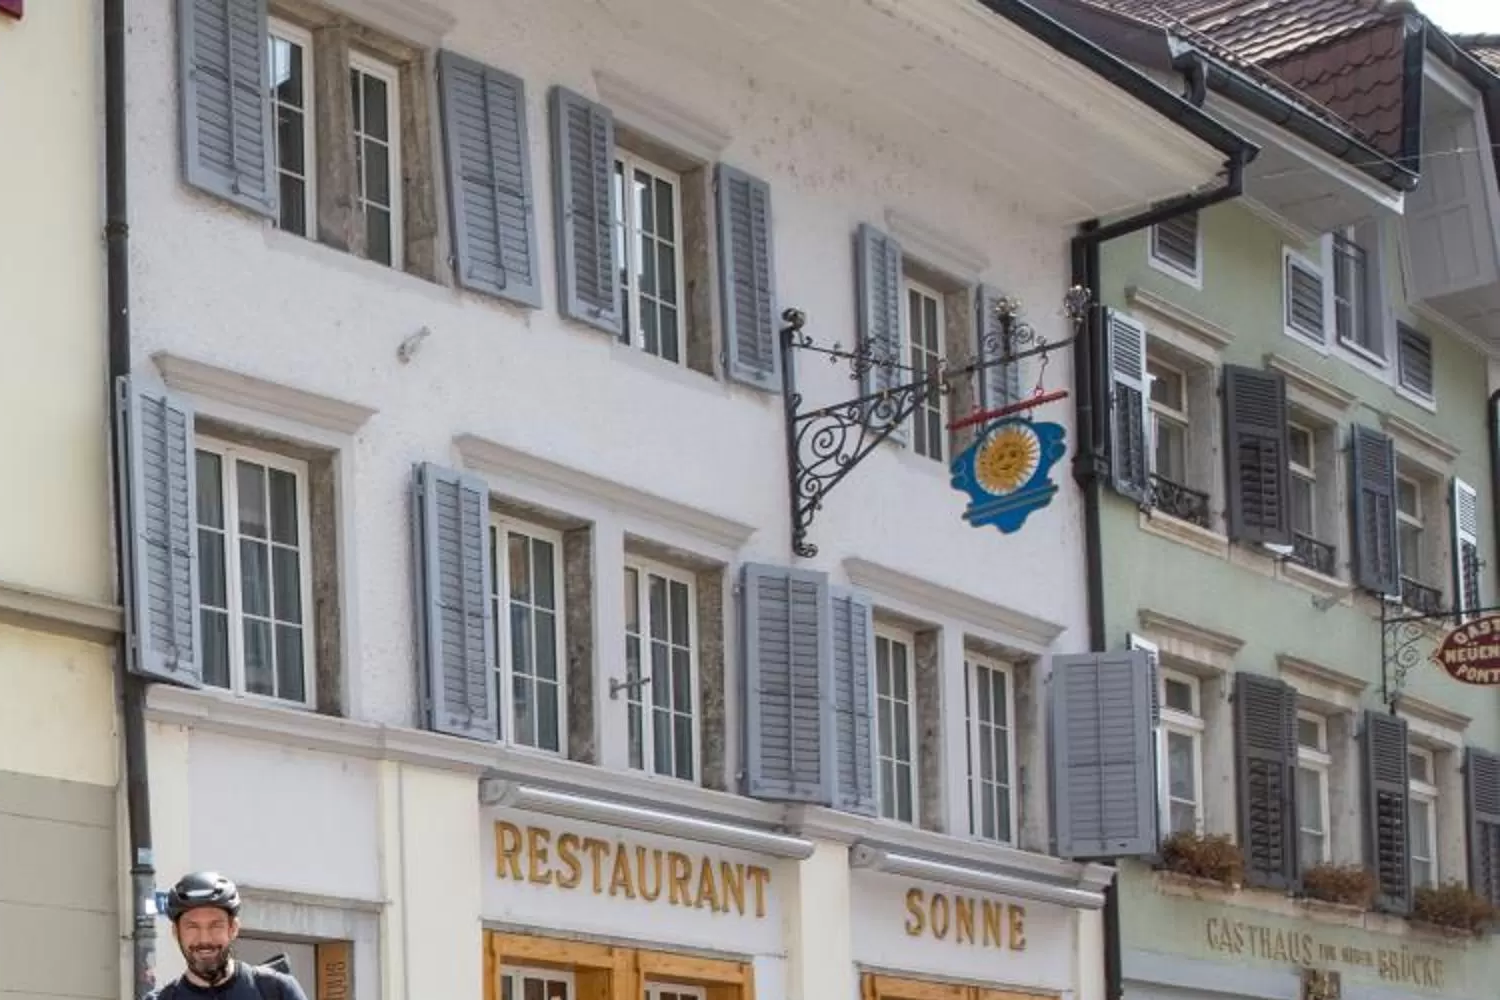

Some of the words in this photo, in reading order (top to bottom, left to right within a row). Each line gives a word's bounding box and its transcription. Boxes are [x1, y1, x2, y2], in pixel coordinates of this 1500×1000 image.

[494, 820, 771, 918] RESTAURANT
[905, 887, 1026, 951] SONNE
[1206, 917, 1313, 966] GASTHAUS
